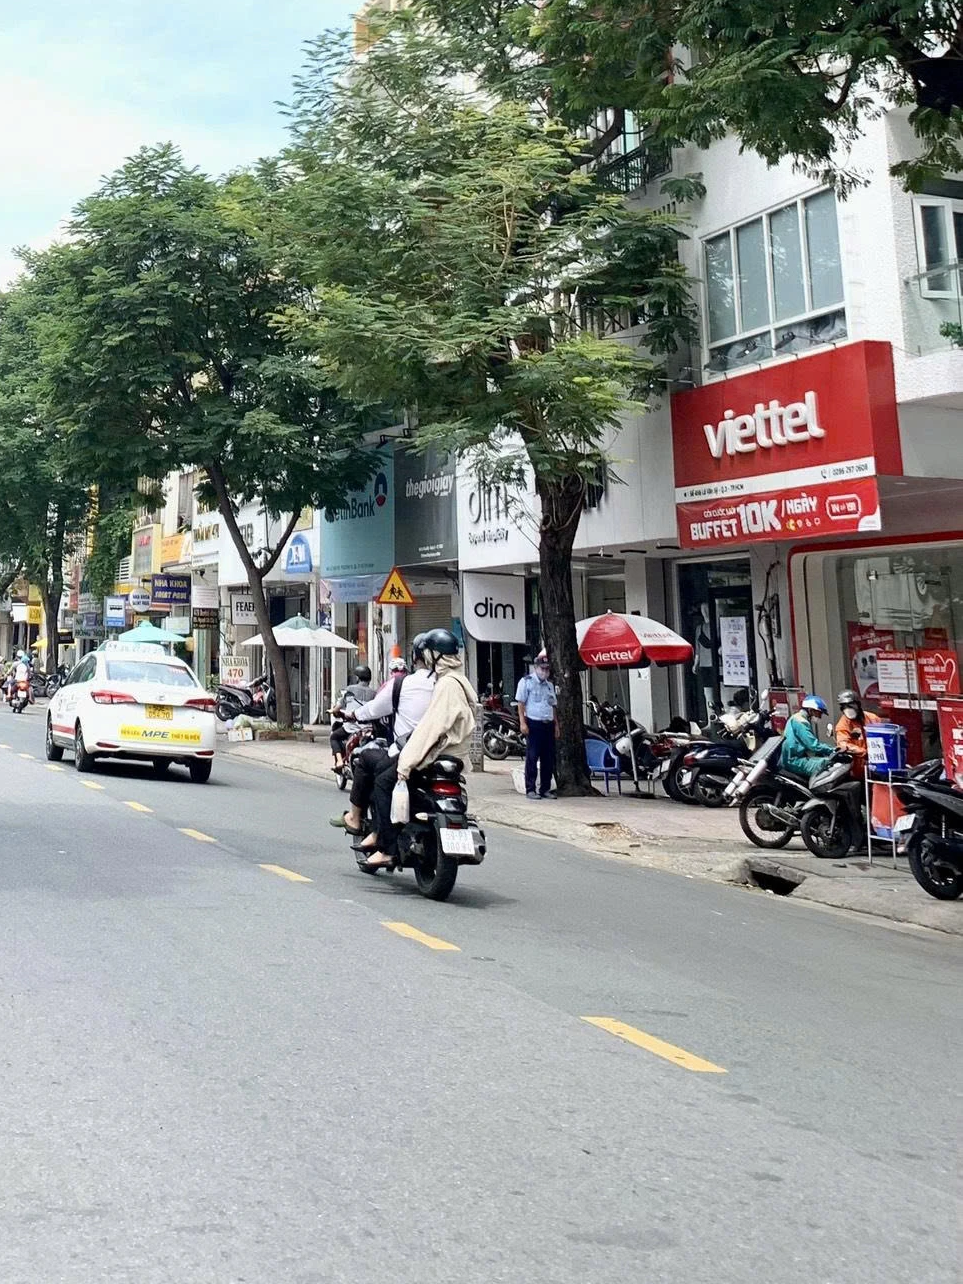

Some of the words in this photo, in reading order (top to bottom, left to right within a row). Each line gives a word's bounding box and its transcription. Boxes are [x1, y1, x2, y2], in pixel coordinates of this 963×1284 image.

[703, 390, 826, 458] viettel
[690, 518, 738, 541] BUFFET
[738, 499, 782, 534] 10K
[154, 579, 168, 587] NHA
[474, 597, 515, 620] dim
[591, 650, 634, 662] viettel
[227, 668, 244, 678] 470
[141, 729, 170, 739] MPE
